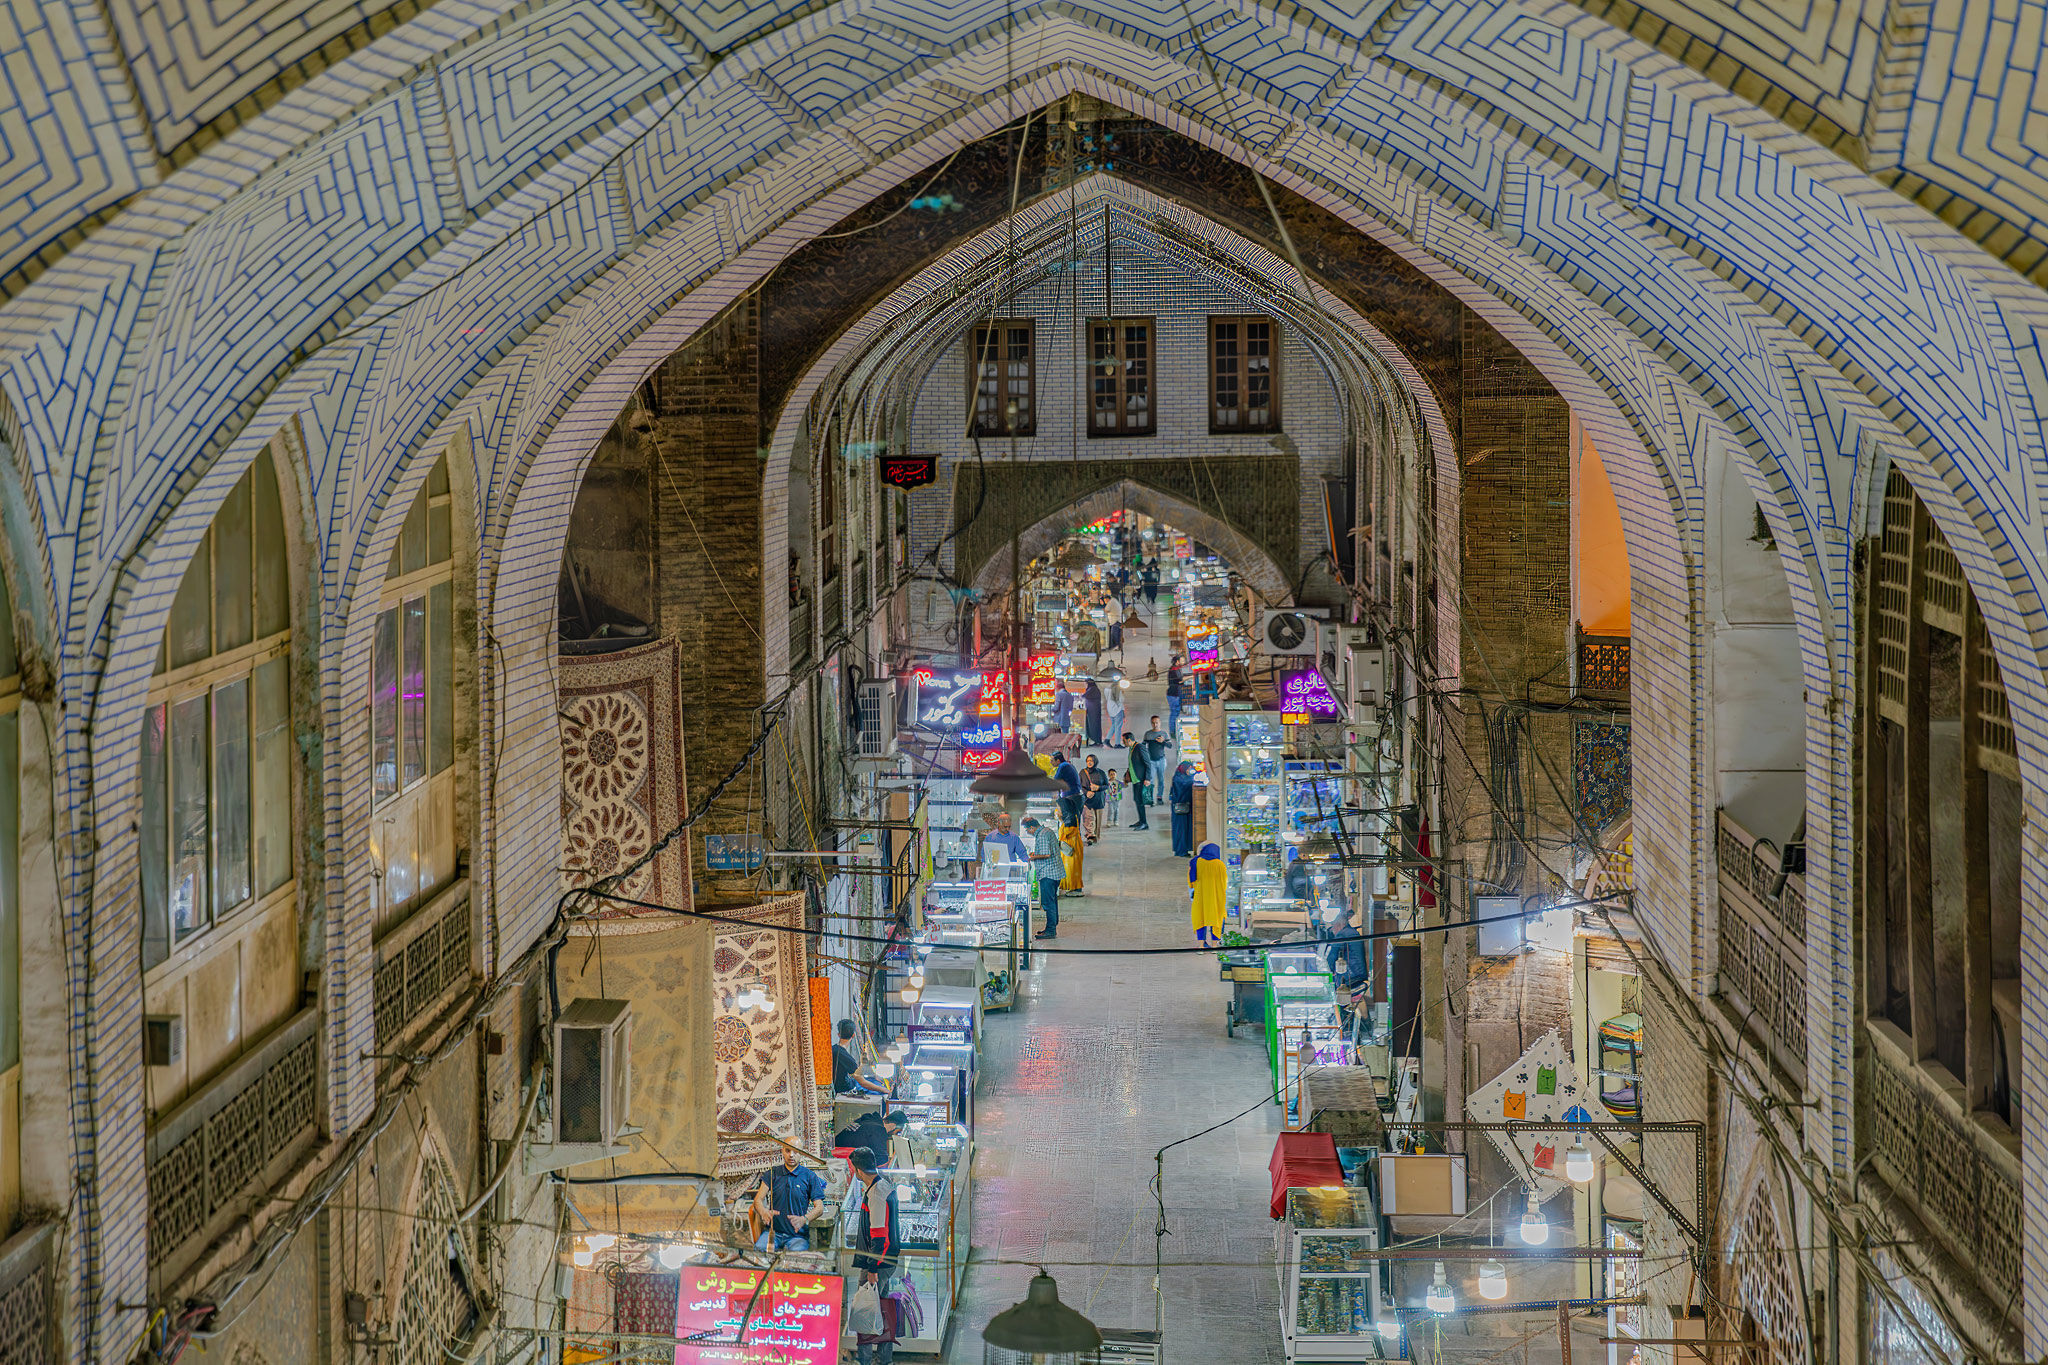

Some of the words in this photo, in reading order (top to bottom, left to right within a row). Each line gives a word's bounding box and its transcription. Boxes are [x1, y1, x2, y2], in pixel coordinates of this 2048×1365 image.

[696, 1271, 757, 1294] فروش
[760, 1281, 769, 1296] و
[773, 1278, 826, 1298] خرید
[689, 1296, 727, 1312] قدیمی
[773, 1301, 831, 1319] انگشترهای
[714, 1316, 746, 1330] بیعی
[749, 1316, 775, 1331] های
[775, 1318, 803, 1331] سنگ
[748, 1334, 791, 1347] نیشابور
[791, 1338, 827, 1350] فیروزه
[699, 1350, 720, 1360] السلام
[734, 1351, 762, 1363] جواد
